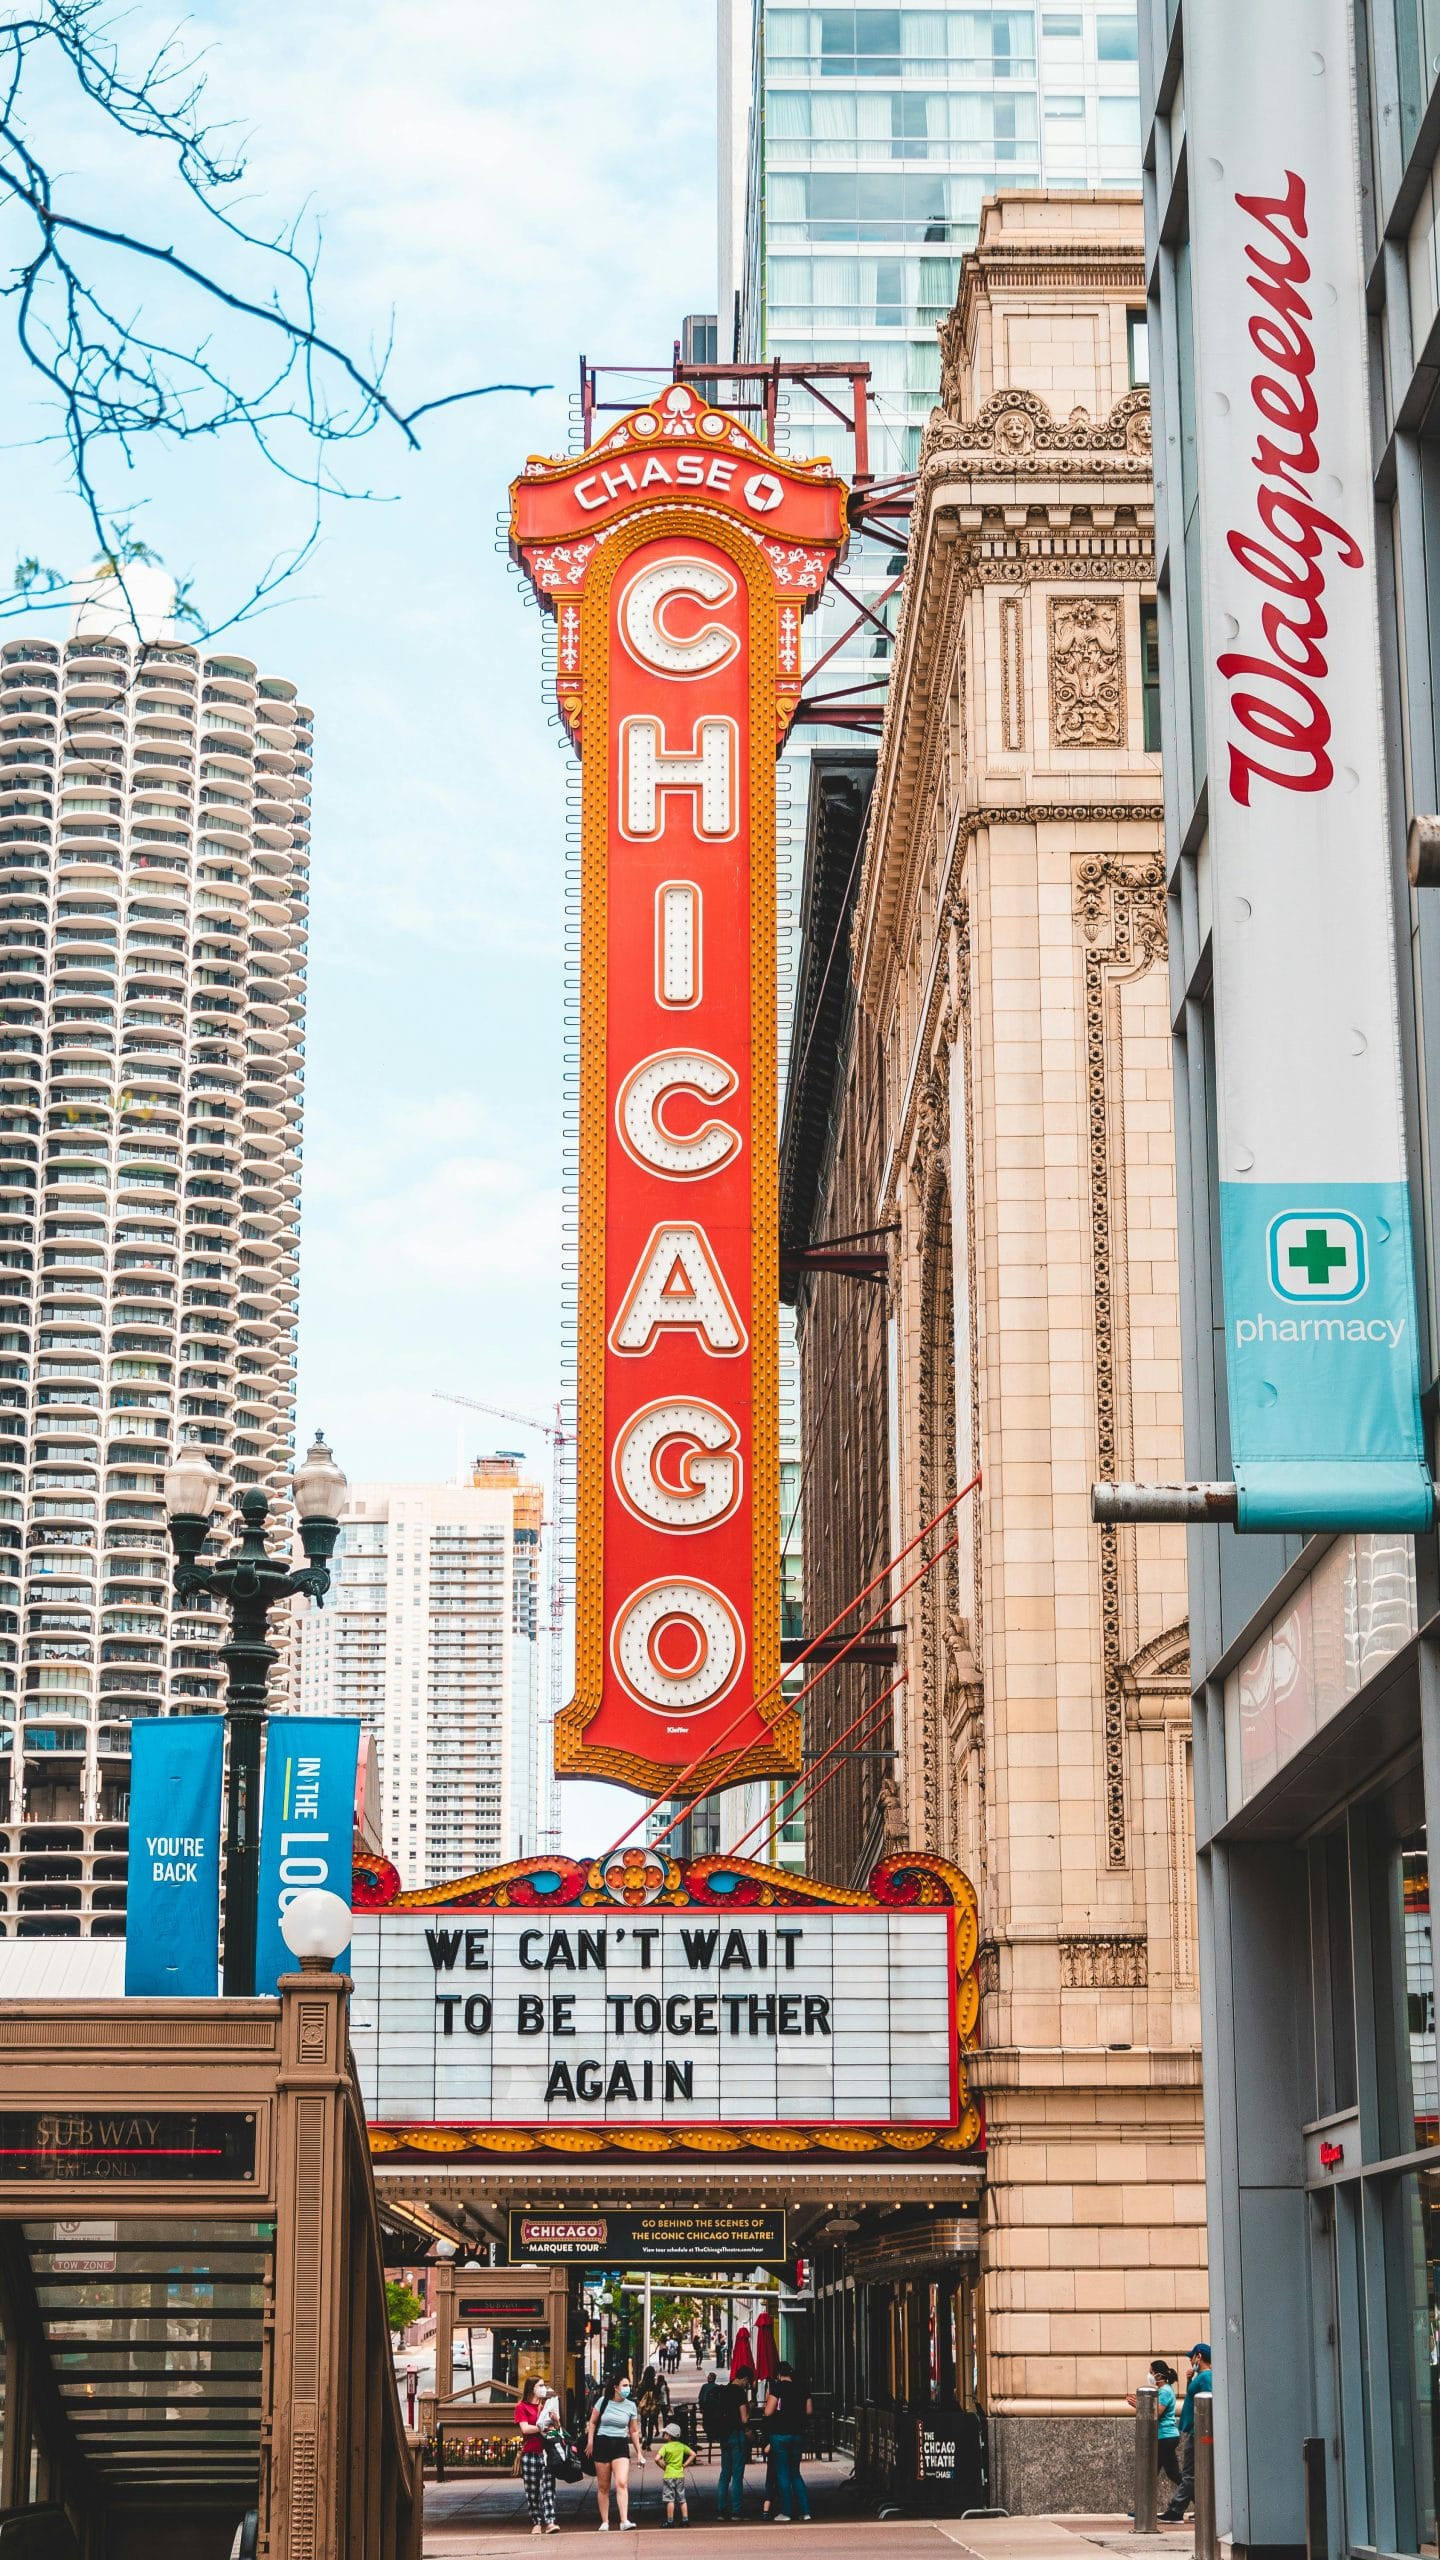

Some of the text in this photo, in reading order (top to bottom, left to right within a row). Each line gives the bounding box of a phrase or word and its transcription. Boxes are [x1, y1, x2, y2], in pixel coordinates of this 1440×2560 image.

[573, 455, 739, 510] CHASE
[1217, 171, 1364, 807] Walgreens
[608, 555, 748, 1718] CHICAGO
[1236, 1313, 1406, 1349] pharmacy
[294, 1757, 321, 1819] IN THE
[146, 1837, 204, 1857] YOU'RE
[153, 1862, 197, 1882] BACK
[424, 1928, 803, 1971] WE CAN'T WAIT
[434, 1994, 832, 2036] TO BE TOGETHER
[543, 2059, 694, 2103] AGAIN
[37, 2119, 161, 2146] SUBWAY
[96, 2159, 138, 2177] ONLY
[530, 2226, 598, 2237] CHICAGO
[641, 2219, 765, 2228] GO BEHIND THE SCENES OF
[632, 2231, 774, 2240] THE ICONIC CHICAGO THEATRE!
[529, 2243, 599, 2253] MARQUEE TOUR
[57, 2261, 110, 2270] TOW ZONE
[923, 2431, 935, 2441] THE
